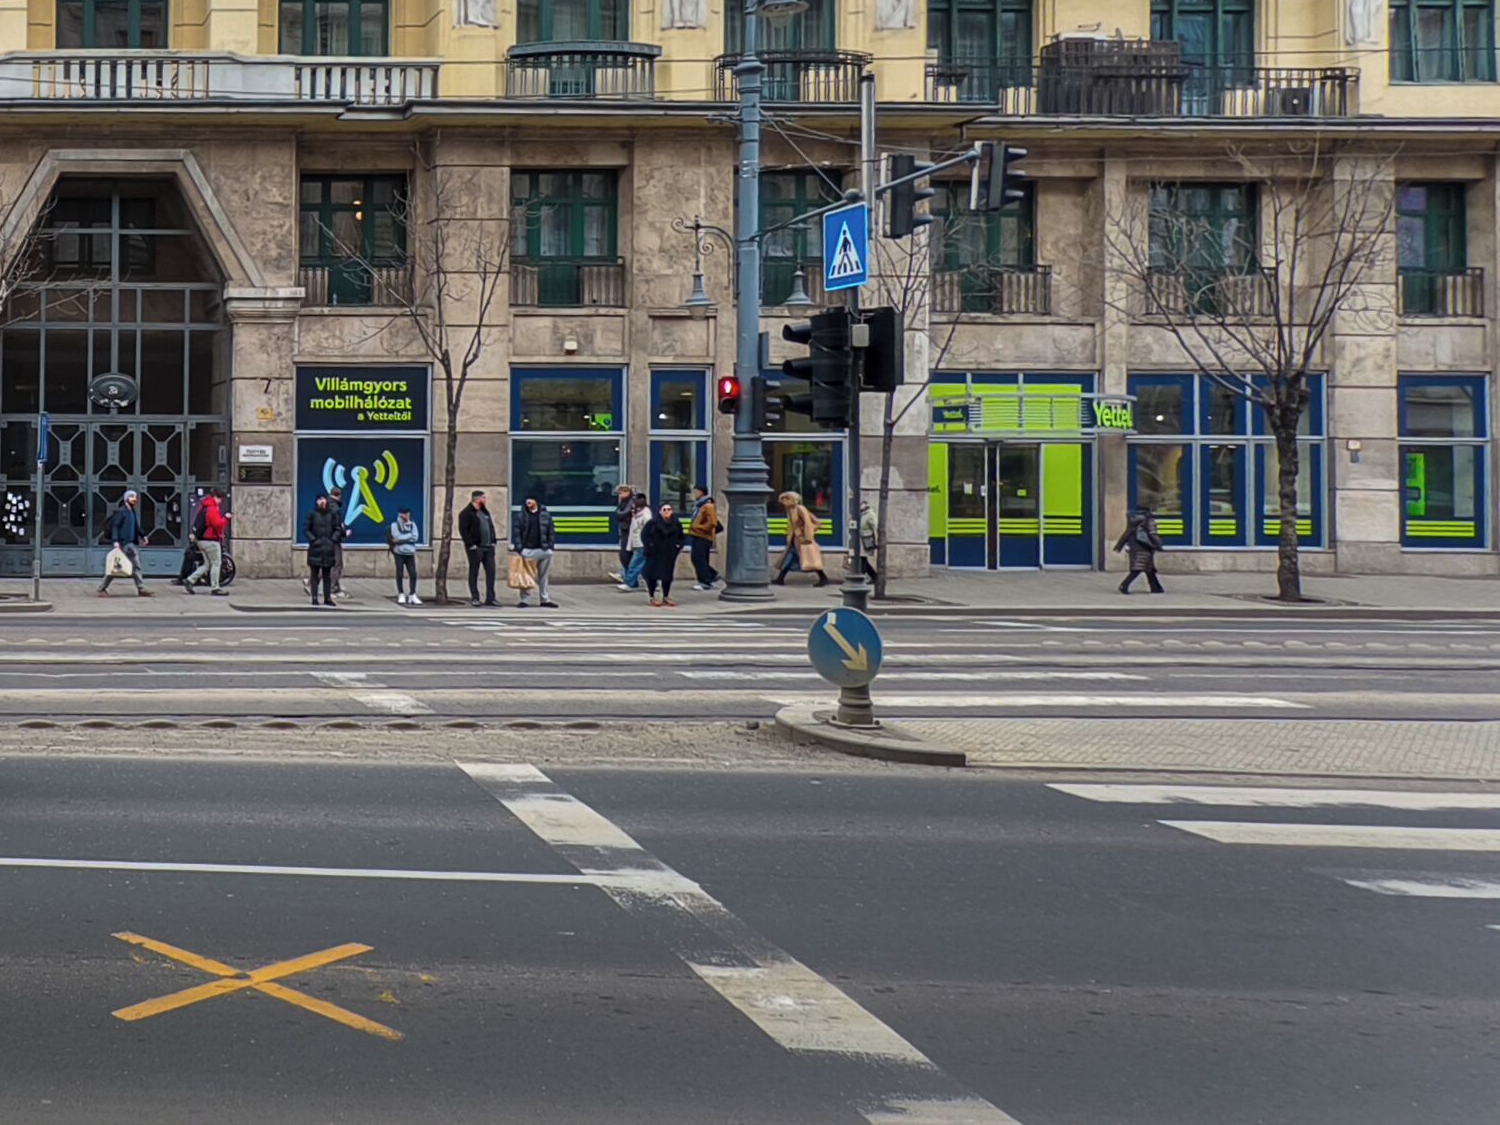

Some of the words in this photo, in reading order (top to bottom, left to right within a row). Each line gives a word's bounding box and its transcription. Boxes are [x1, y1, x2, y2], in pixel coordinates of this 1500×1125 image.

[315, 377, 408, 394] Villámgyors
[310, 395, 412, 409] mobilhálózat
[357, 413, 364, 421] a
